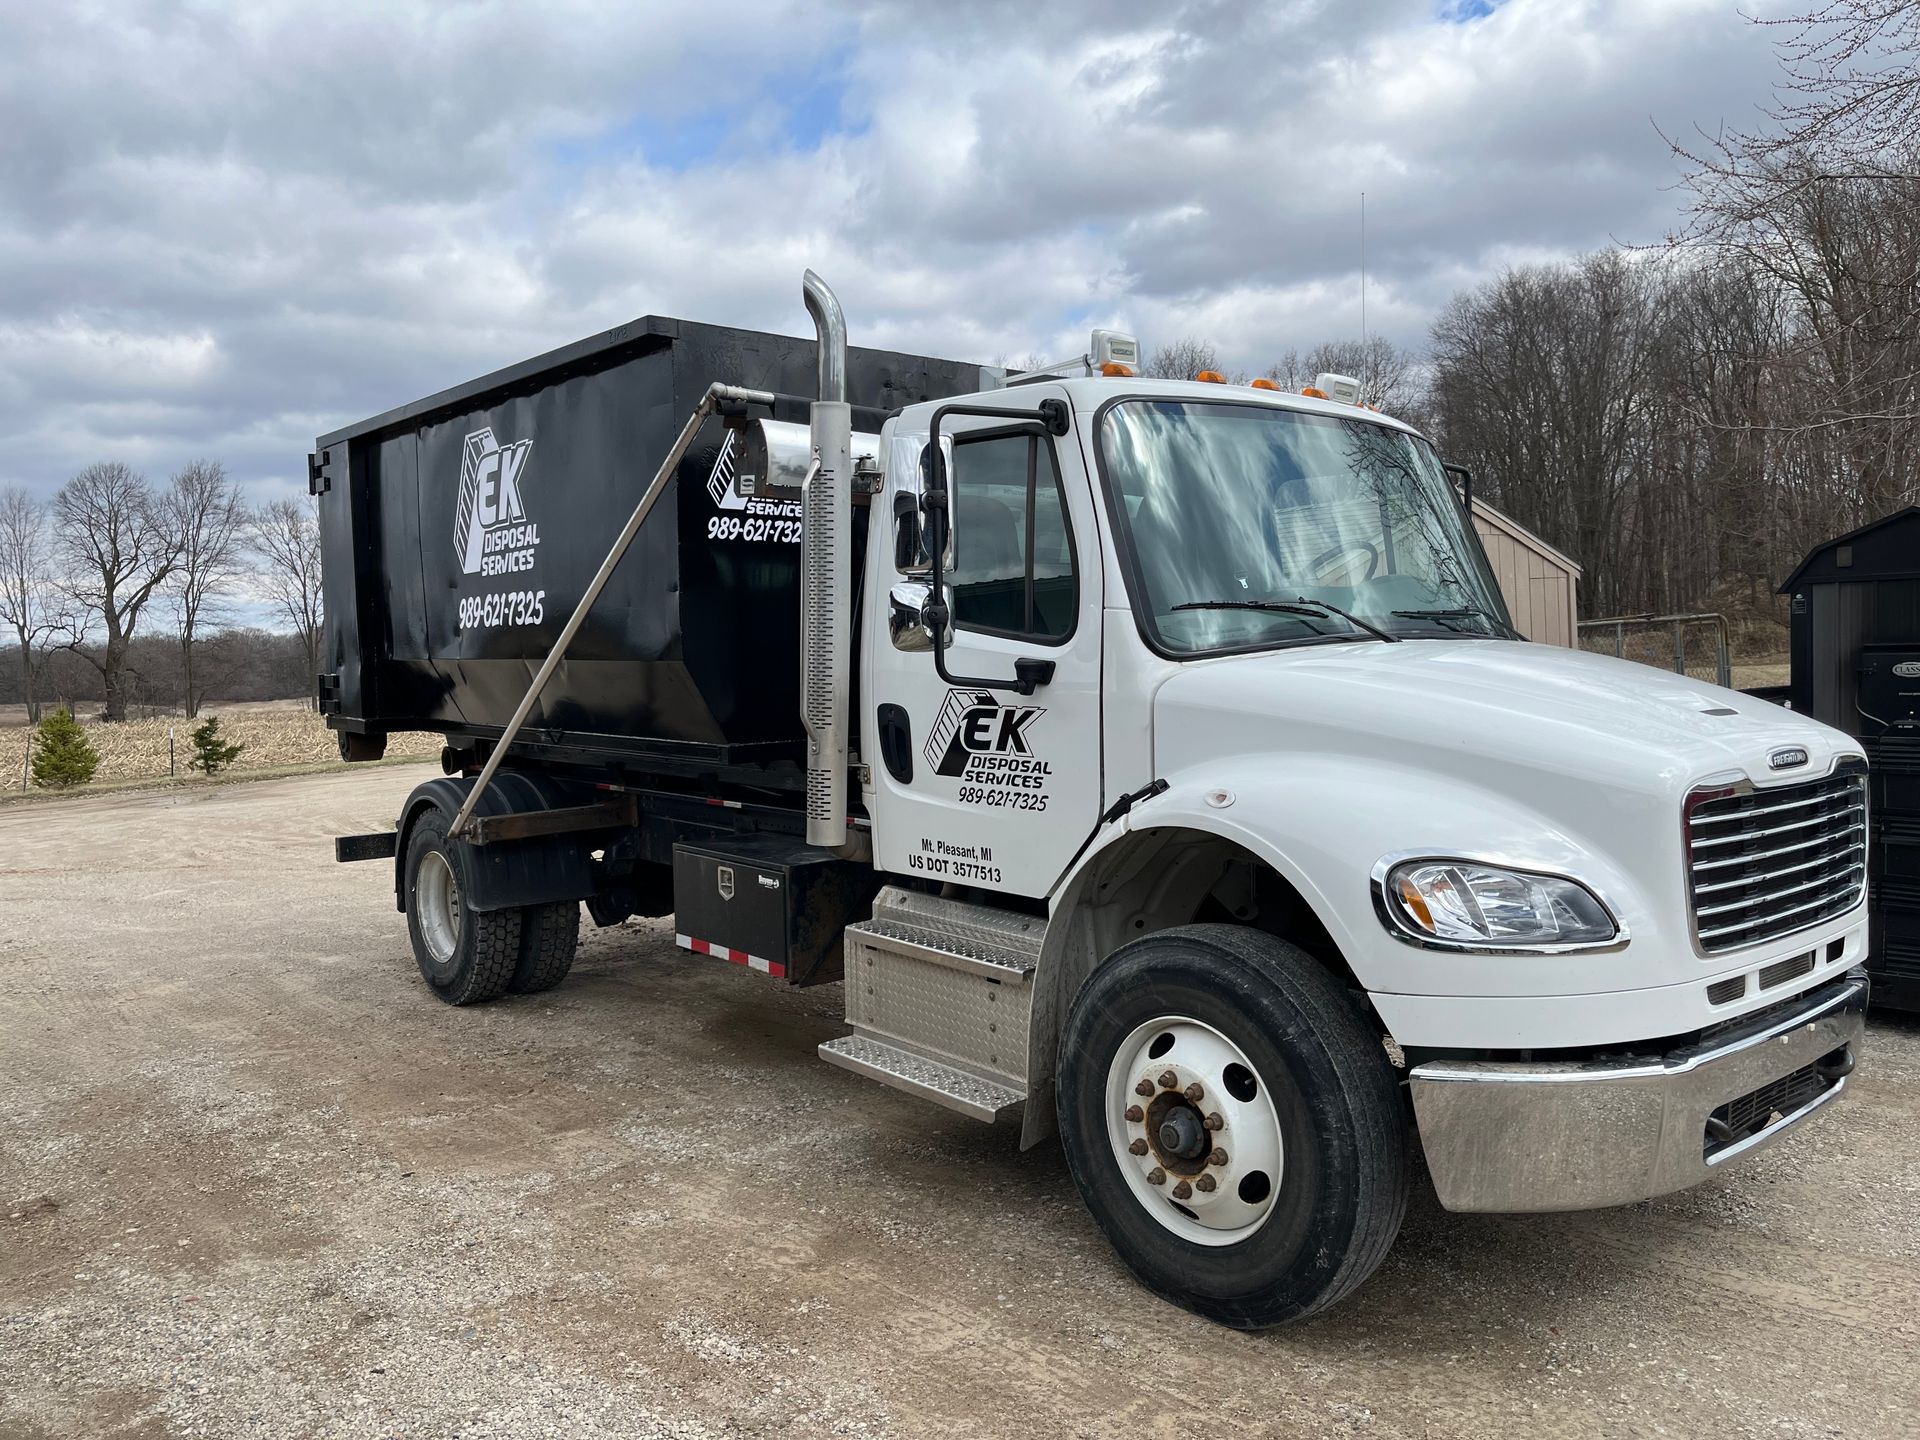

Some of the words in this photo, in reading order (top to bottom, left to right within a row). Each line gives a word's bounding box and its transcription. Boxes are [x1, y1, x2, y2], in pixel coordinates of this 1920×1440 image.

[476, 443, 530, 526] EK
[746, 502, 802, 516] SERVICE
[484, 525, 540, 553] DISPOSAL
[708, 516, 802, 543] 989-621-732
[481, 549, 535, 577] SERVICES
[459, 590, 545, 629] 989-621-7325
[961, 706, 1042, 755] EK
[970, 756, 1052, 775] DISPOSAL
[964, 770, 1044, 789] SERVICES
[959, 787, 1049, 812] 989-621-7325
[921, 838, 935, 853] Mt.
[937, 840, 979, 862] Pleasant,
[980, 847, 992, 861] MI
[909, 854, 924, 869] US
[927, 857, 949, 873] DOT
[952, 861, 1002, 883] 3577513
